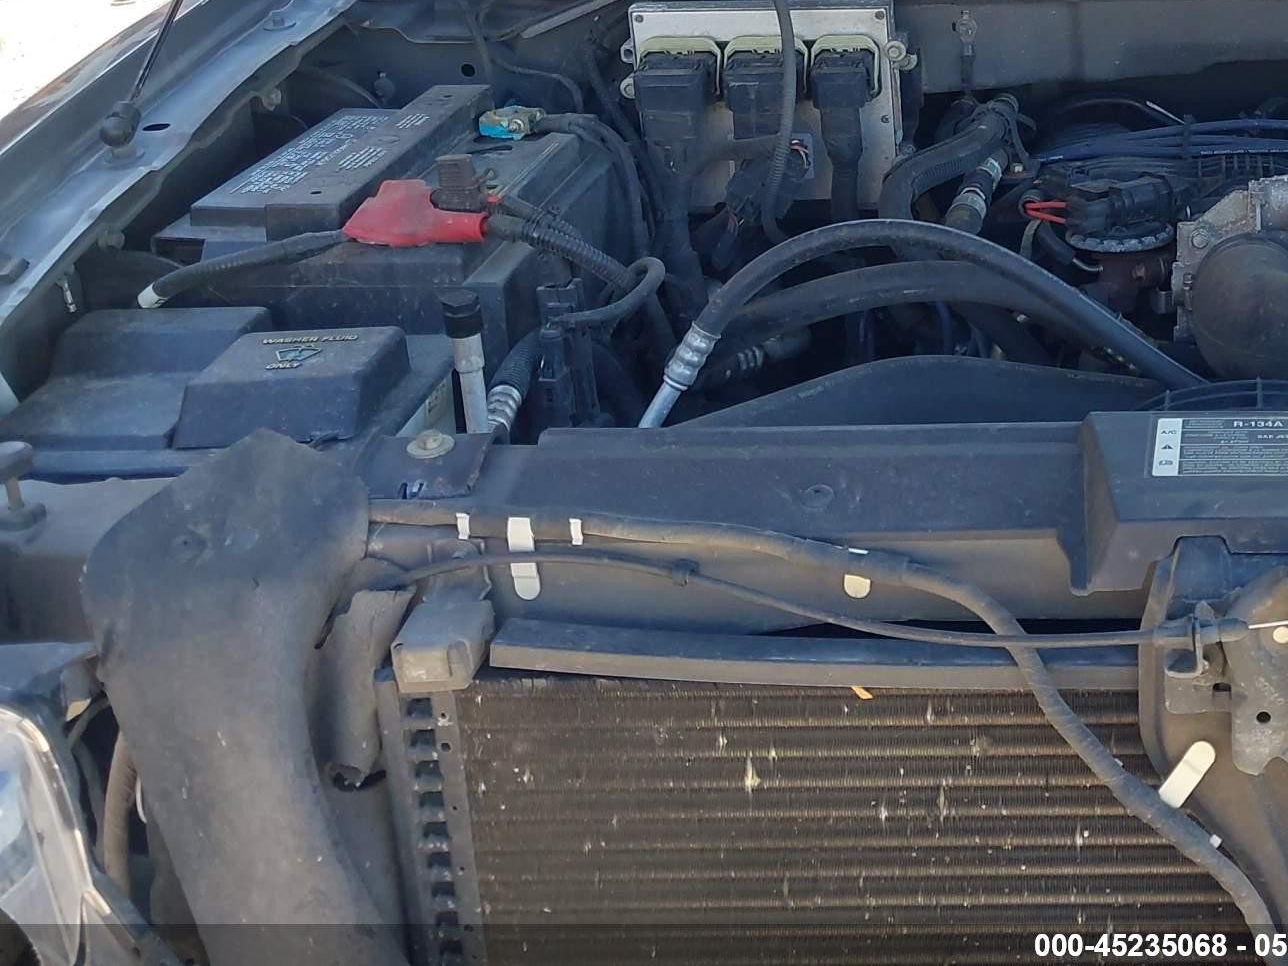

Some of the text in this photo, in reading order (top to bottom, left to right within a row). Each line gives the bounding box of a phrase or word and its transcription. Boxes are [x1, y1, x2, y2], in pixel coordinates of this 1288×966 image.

[262, 334, 359, 345] WASHER FLUID
[265, 362, 301, 370] ONLY
[1233, 420, 1283, 428] R-134A
